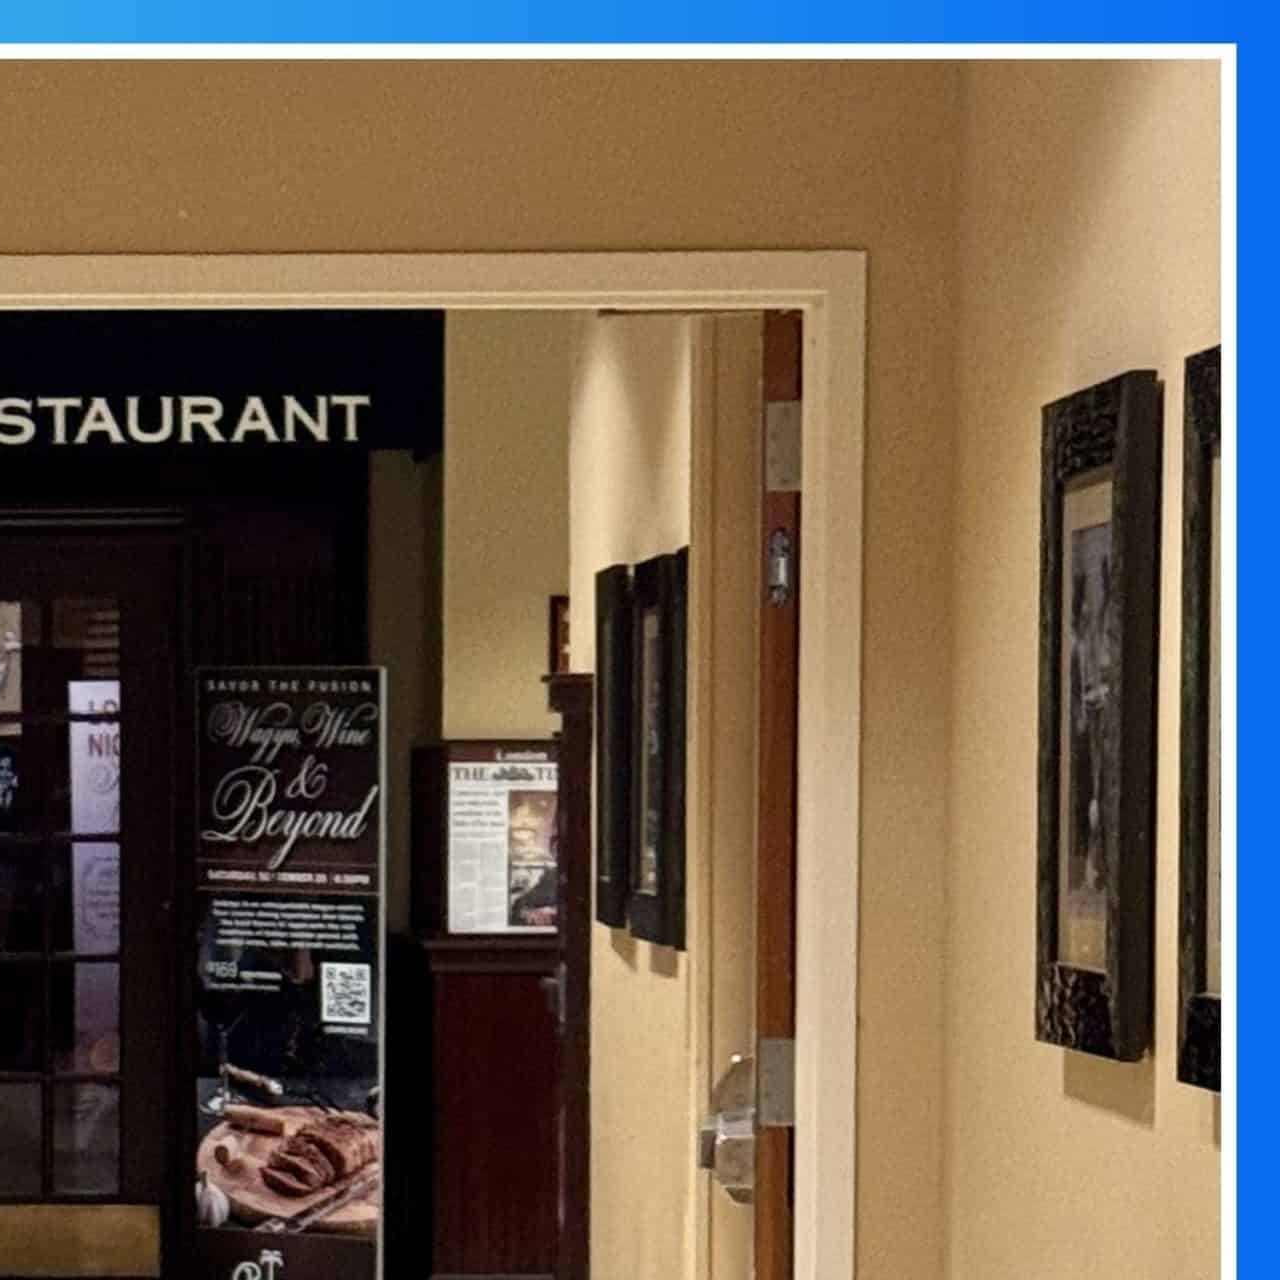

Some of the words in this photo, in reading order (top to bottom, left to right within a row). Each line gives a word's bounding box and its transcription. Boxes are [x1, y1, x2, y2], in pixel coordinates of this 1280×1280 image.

[208, 680, 259, 691] SAVOR
[271, 680, 299, 691] THE
[308, 681, 372, 692] FUSION
[302, 702, 379, 748] Wine
[285, 754, 329, 799] &
[454, 767, 485, 781] THE
[201, 764, 379, 870] Beyond
